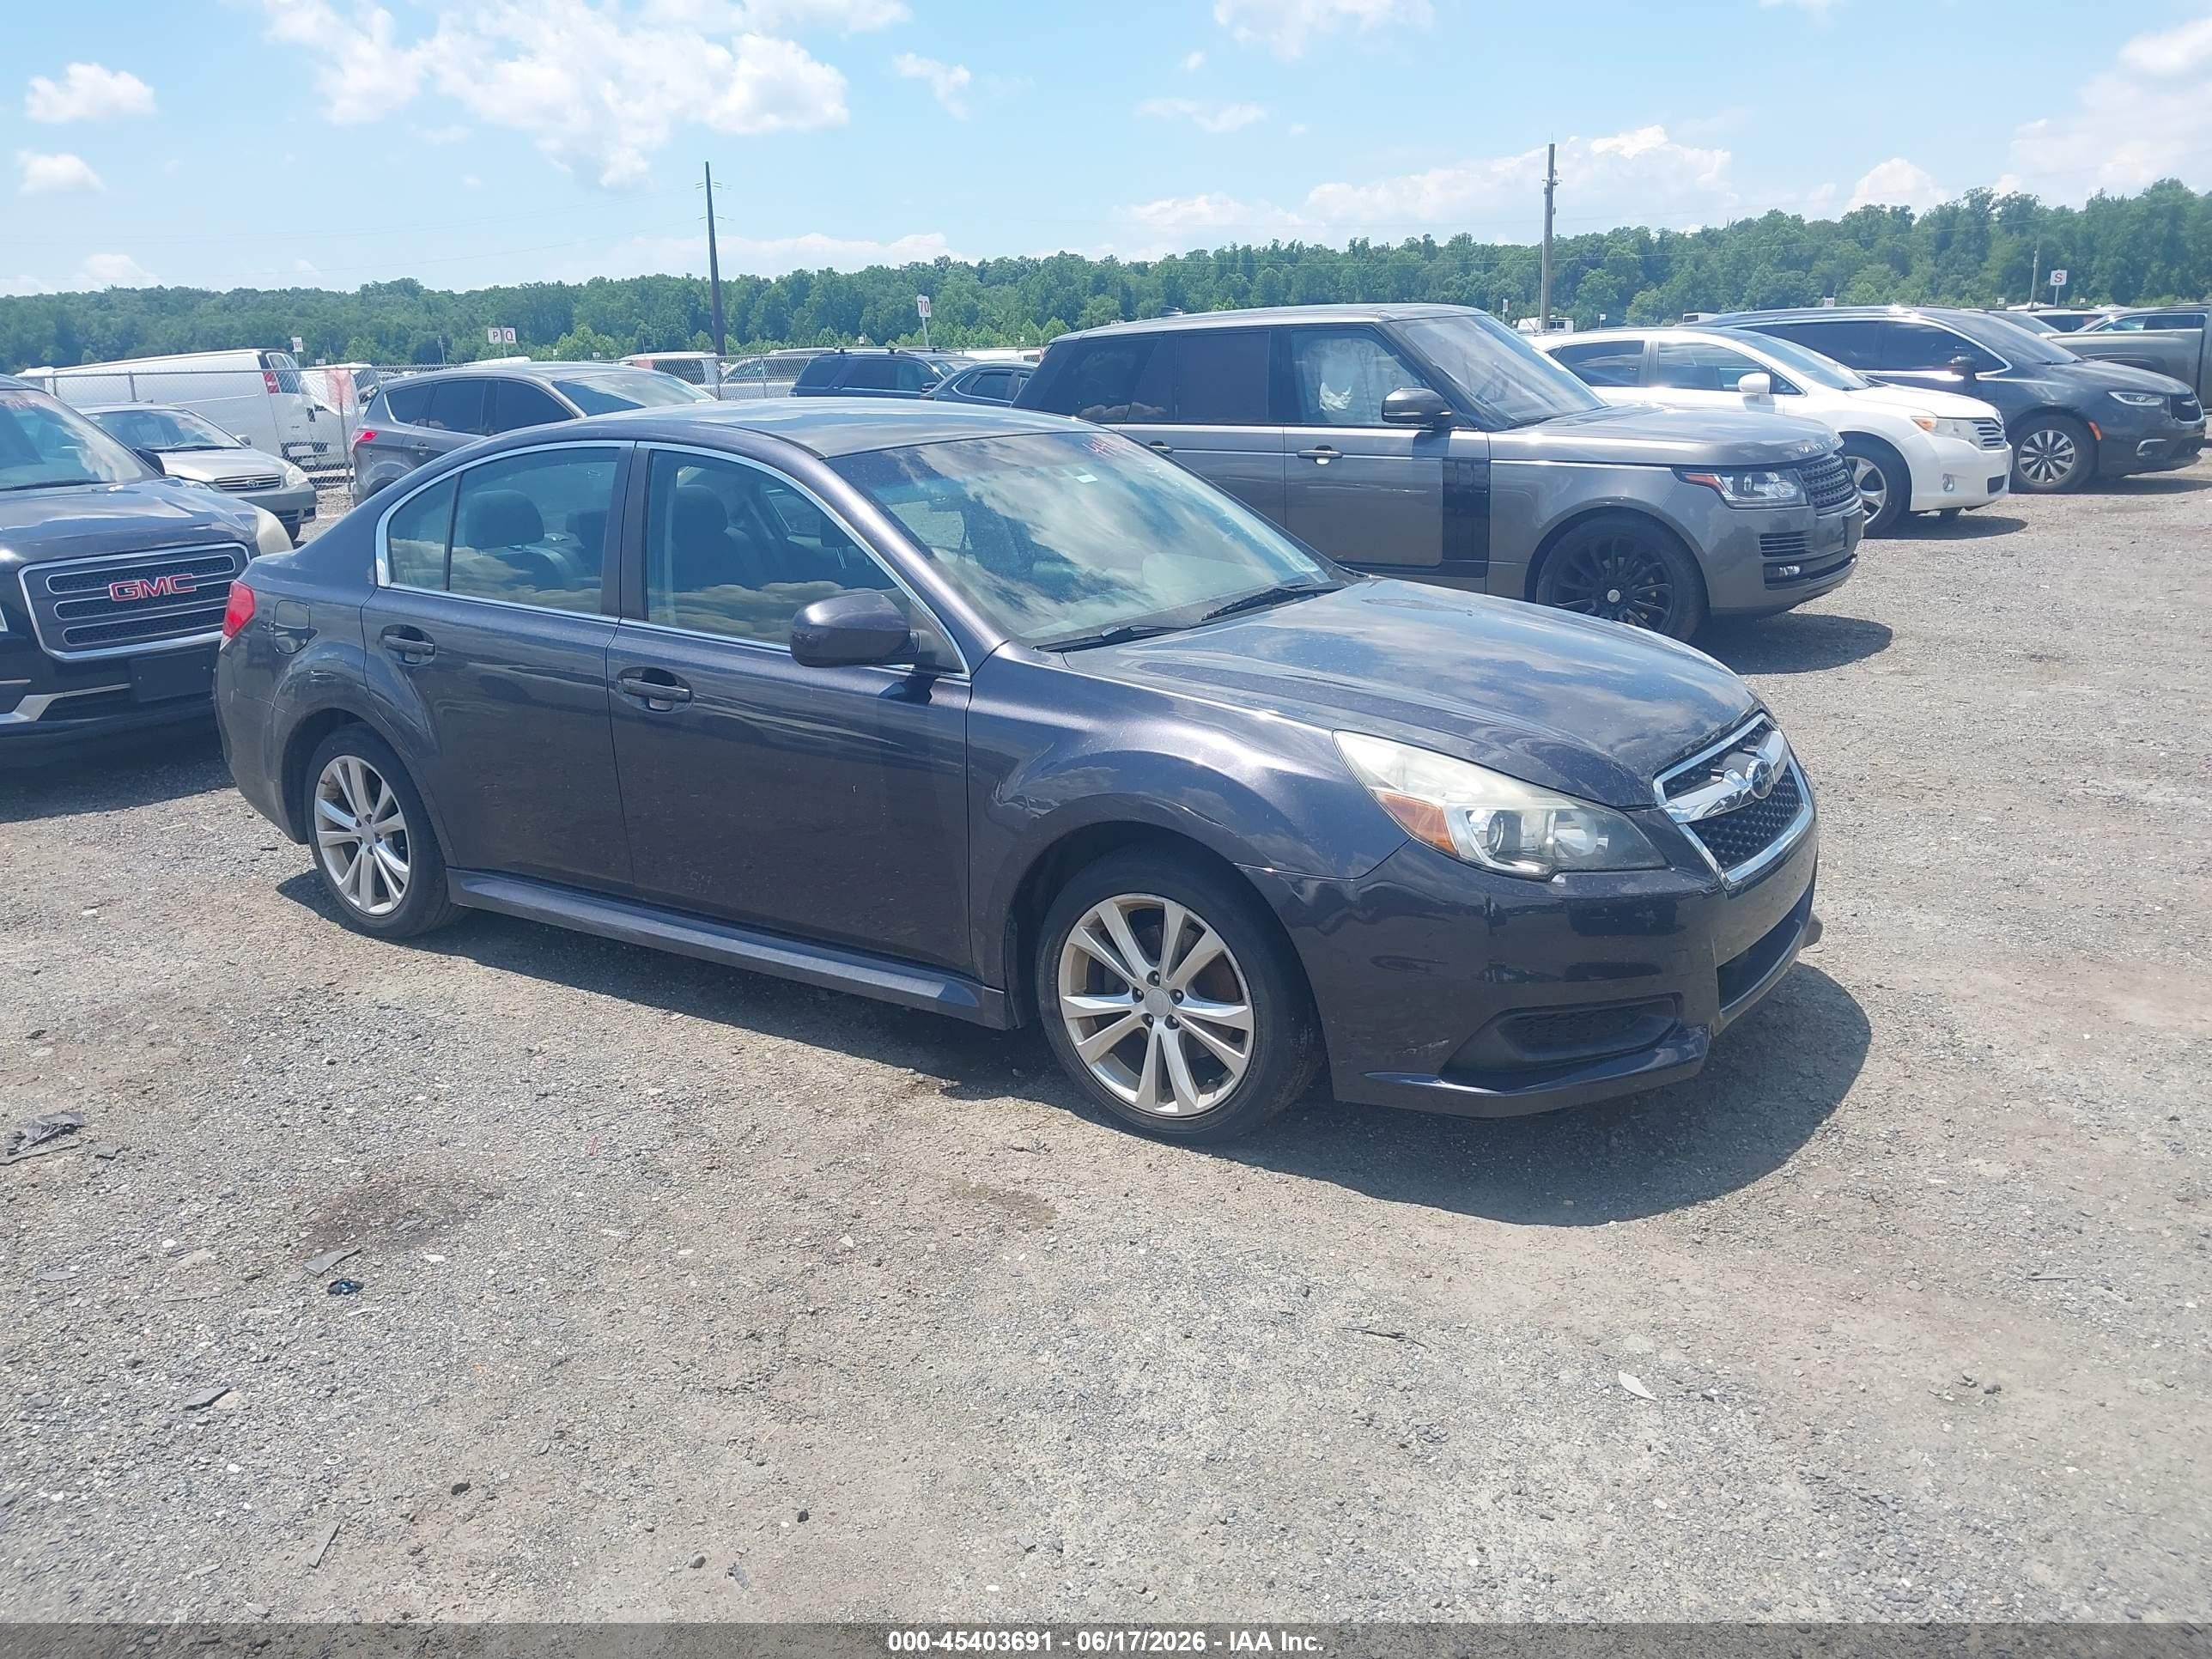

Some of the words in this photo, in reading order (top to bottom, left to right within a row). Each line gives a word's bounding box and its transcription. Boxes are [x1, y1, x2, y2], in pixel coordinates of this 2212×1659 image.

[2054, 272, 2063, 283] S
[918, 301, 930, 313] 70
[505, 330, 514, 342] Q
[108, 573, 197, 602] GMC
